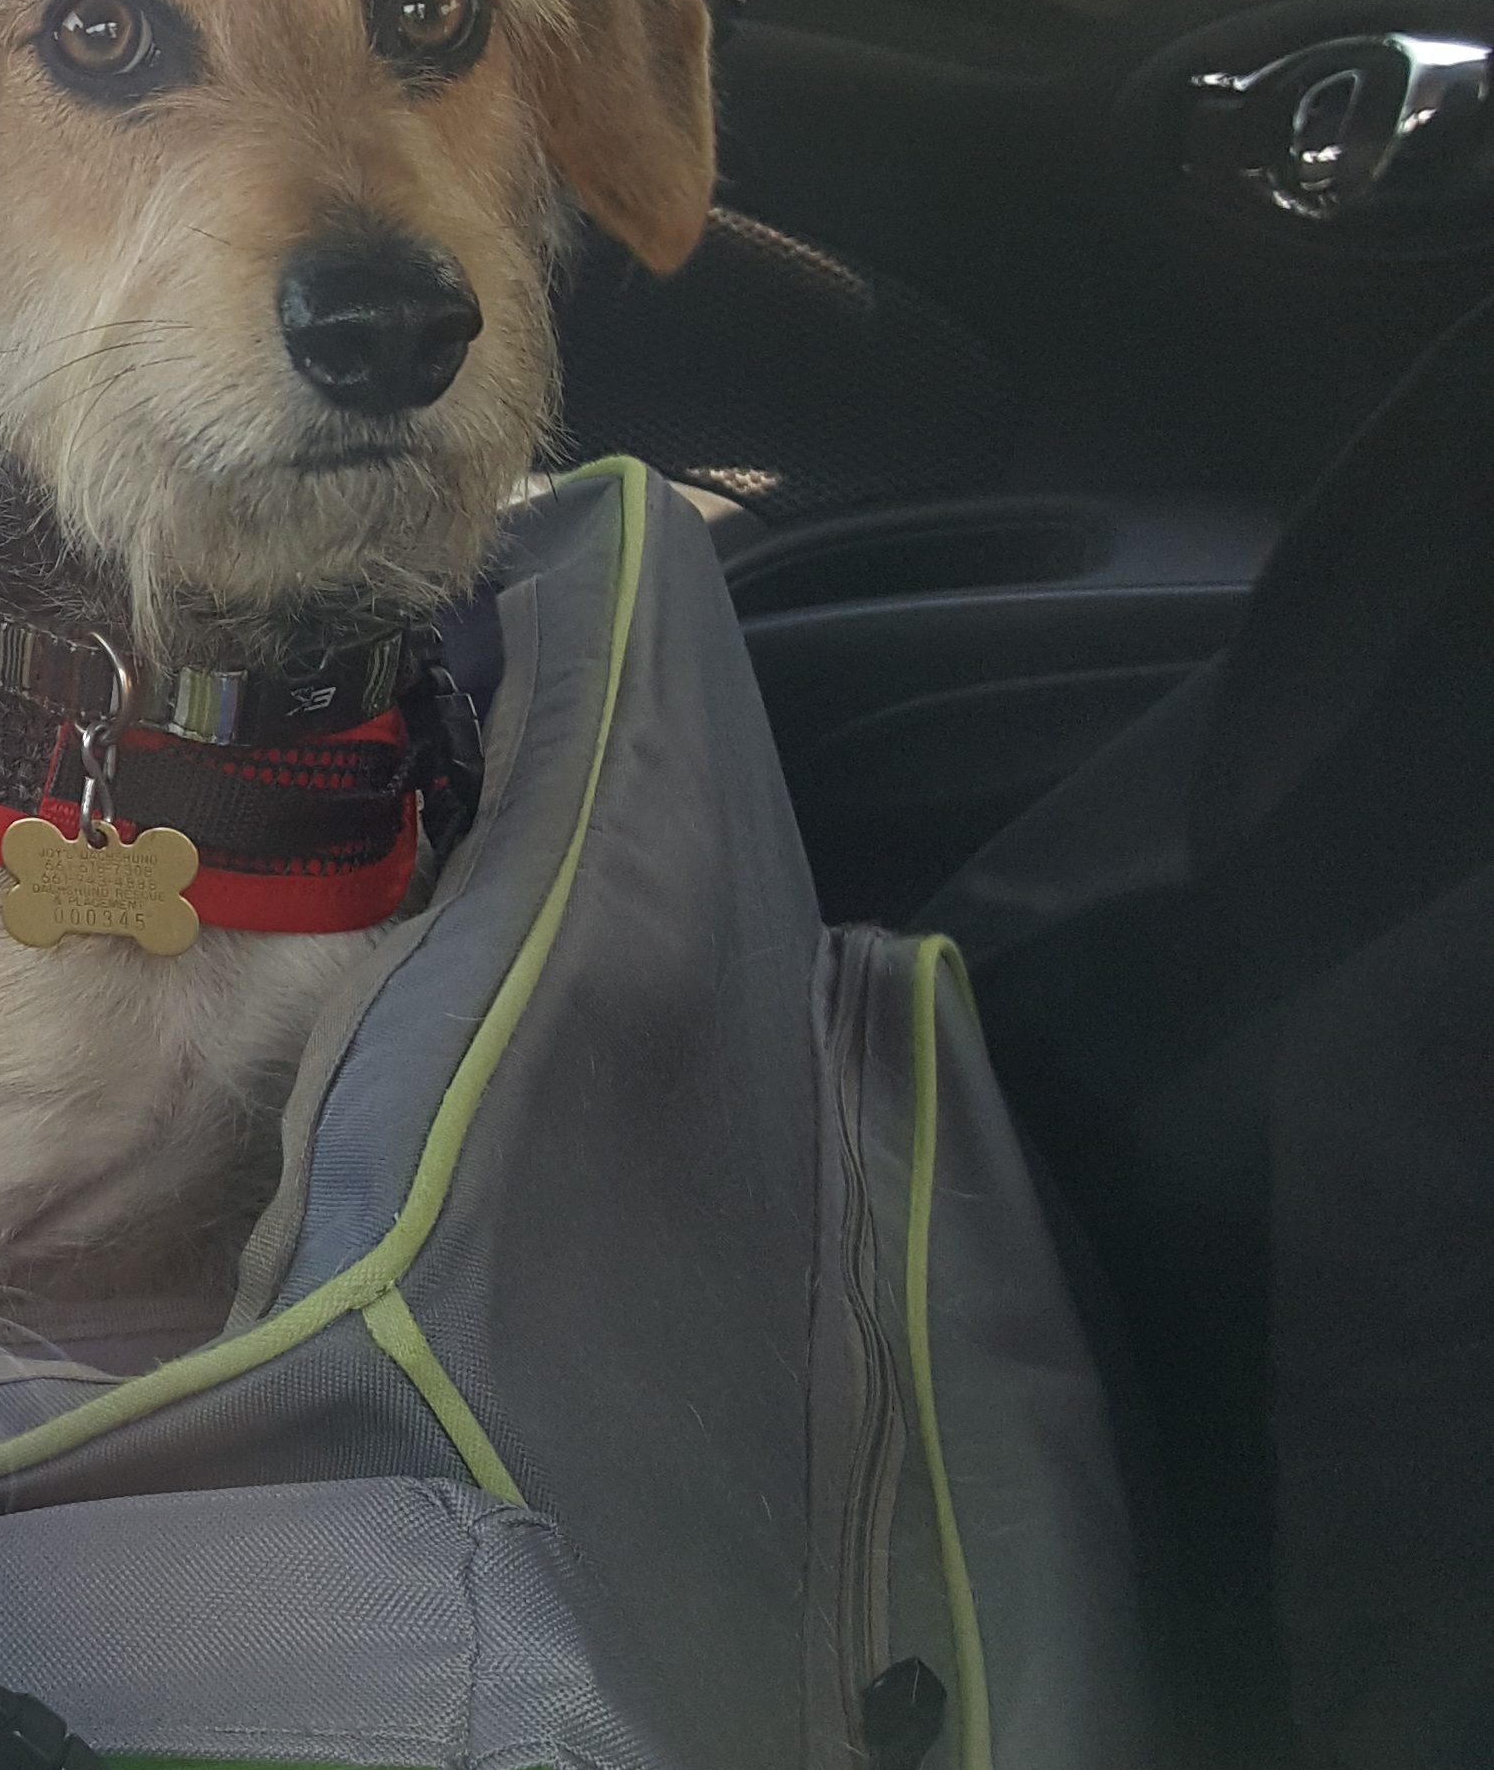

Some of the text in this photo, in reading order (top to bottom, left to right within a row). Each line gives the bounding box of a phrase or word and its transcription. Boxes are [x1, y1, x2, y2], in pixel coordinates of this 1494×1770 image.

[68, 895, 145, 910] PLACEMENT
[115, 888, 165, 902] RESCUE
[53, 906, 147, 932] 000345
